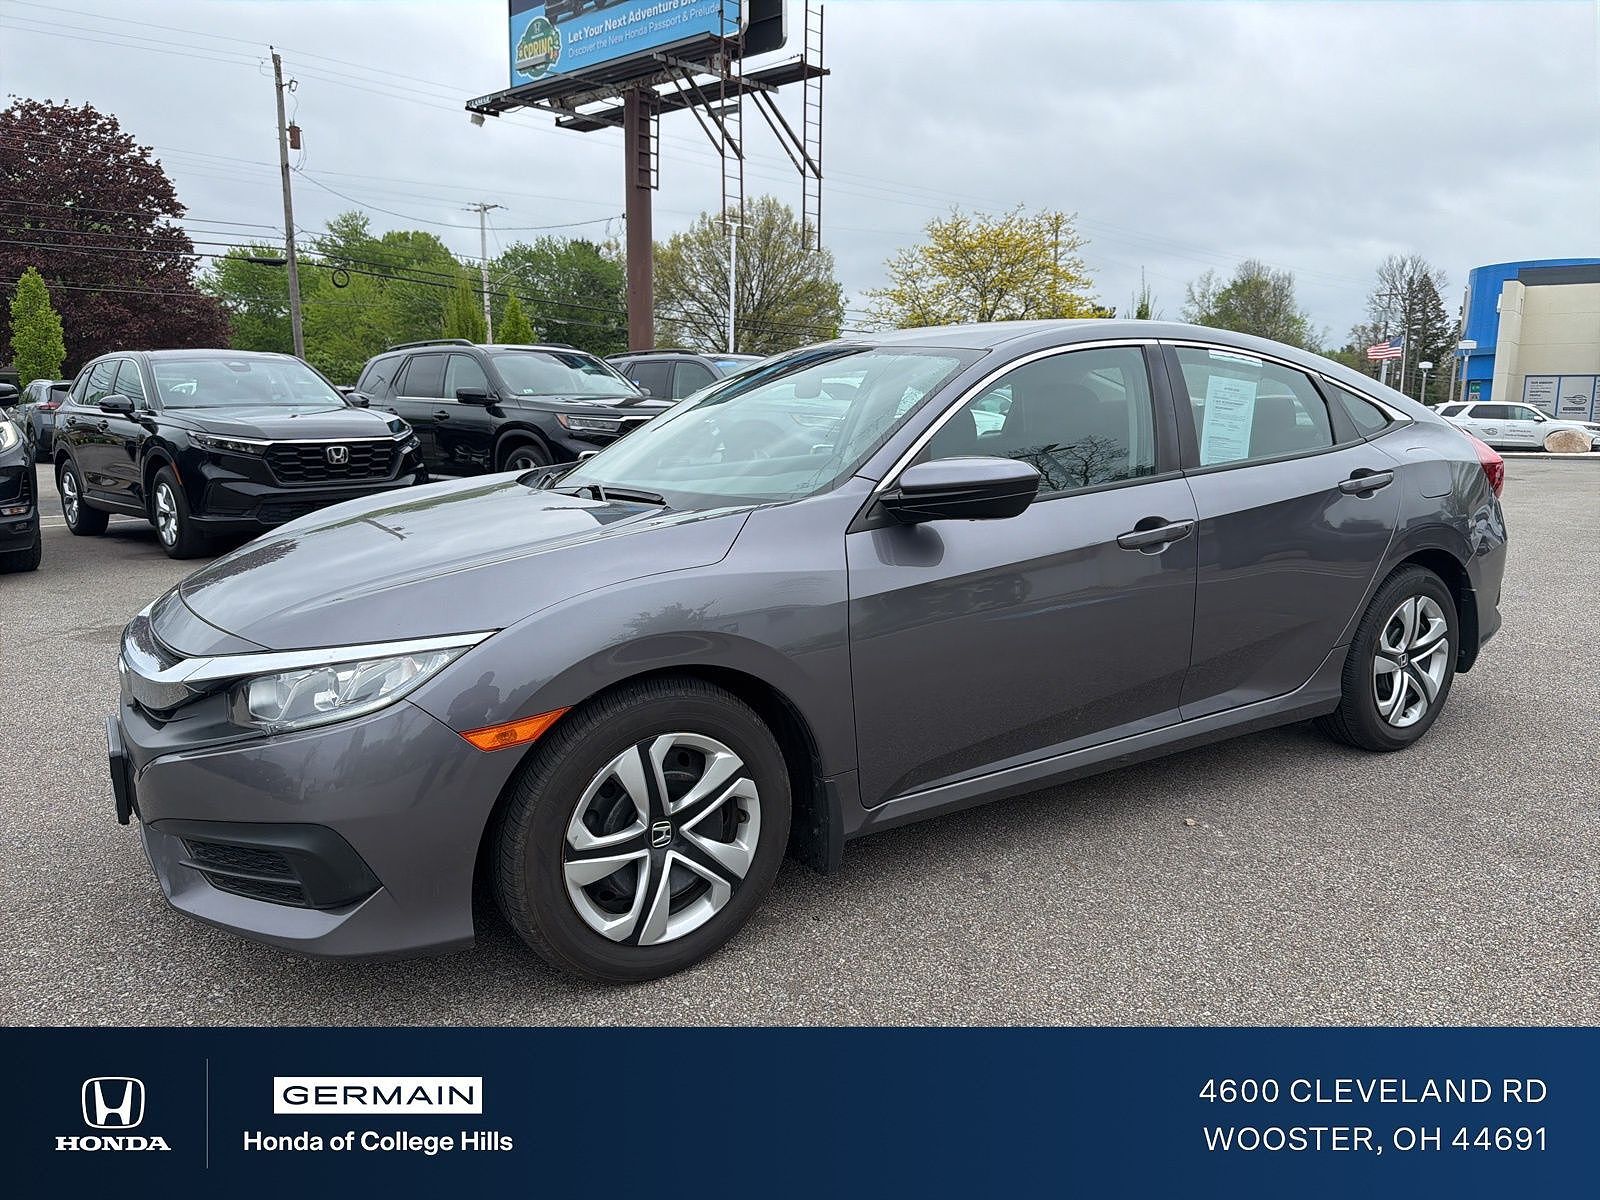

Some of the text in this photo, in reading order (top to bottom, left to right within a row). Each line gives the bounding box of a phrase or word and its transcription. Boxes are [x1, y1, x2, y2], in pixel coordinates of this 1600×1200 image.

[567, 30, 583, 44] Let
[584, 23, 604, 38] Your
[604, 14, 627, 32] Next
[628, 0, 679, 25] Adventure
[625, 27, 648, 41] Honda
[649, 14, 682, 34] Passport
